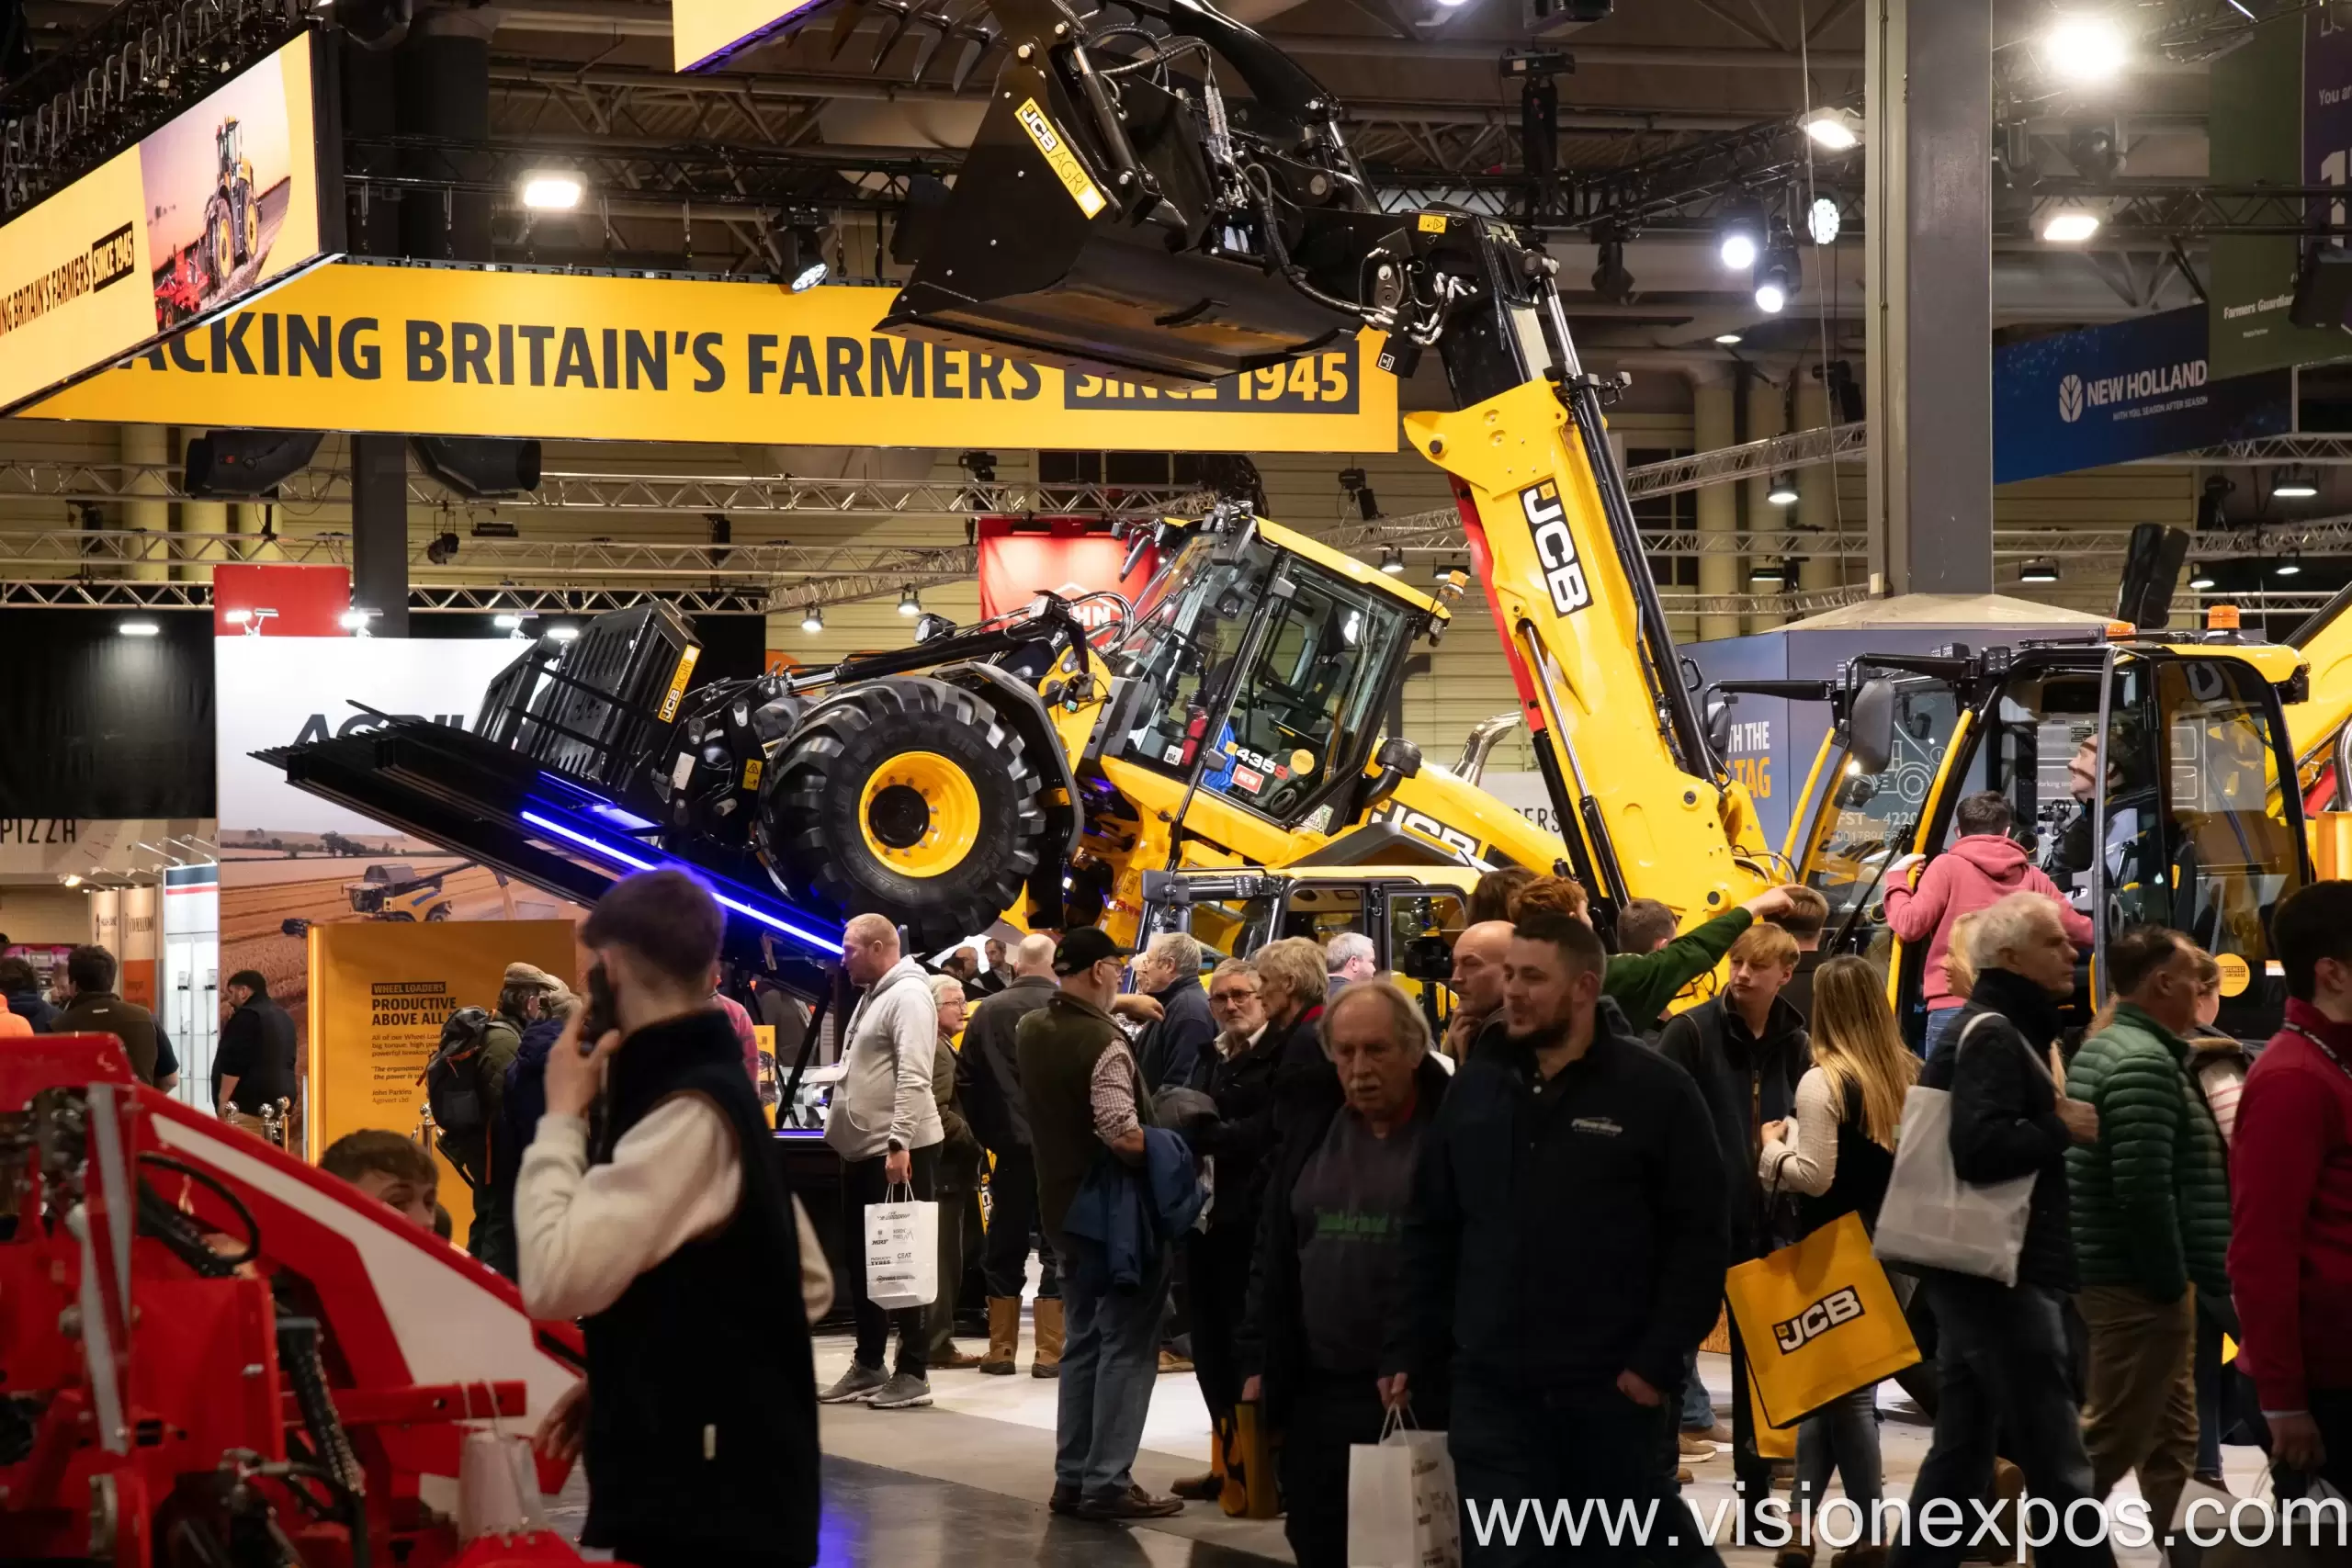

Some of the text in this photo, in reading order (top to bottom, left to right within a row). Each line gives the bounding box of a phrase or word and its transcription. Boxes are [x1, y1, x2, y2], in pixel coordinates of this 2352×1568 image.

[2319, 88, 2339, 106] You
[1021, 109, 1088, 195] JCB AGRI
[14, 274, 51, 330] BRITAIN'S
[51, 251, 90, 310] FARMERS
[93, 240, 115, 285] SINCE
[114, 230, 133, 273] 1945
[2223, 293, 2295, 320] Farmers Guardian
[405, 319, 726, 394] BRITAIN'S
[746, 333, 1042, 401] FARMERS
[2086, 359, 2208, 407] NEW HOLLAND
[2185, 395, 2208, 409] SEASON
[1524, 488, 1589, 614] JCB
[662, 658, 693, 719] JCB AGRI
[1745, 721, 1770, 751] THE
[1236, 749, 1289, 780] 435S
[1734, 756, 1771, 798] TAG
[1238, 771, 1259, 786] NEW
[0, 818, 76, 843] PIZZA
[1513, 807, 1562, 833] ERS
[373, 983, 445, 994] WHEEL LOADERS
[372, 997, 457, 1010] PRODUCTIVE
[371, 1011, 444, 1026] ABOVE ALL
[404, 1032, 425, 1041] Wheel
[372, 1050, 401, 1058] powerful
[386, 1074, 405, 1082] power
[1780, 1290, 1860, 1351] JCB
